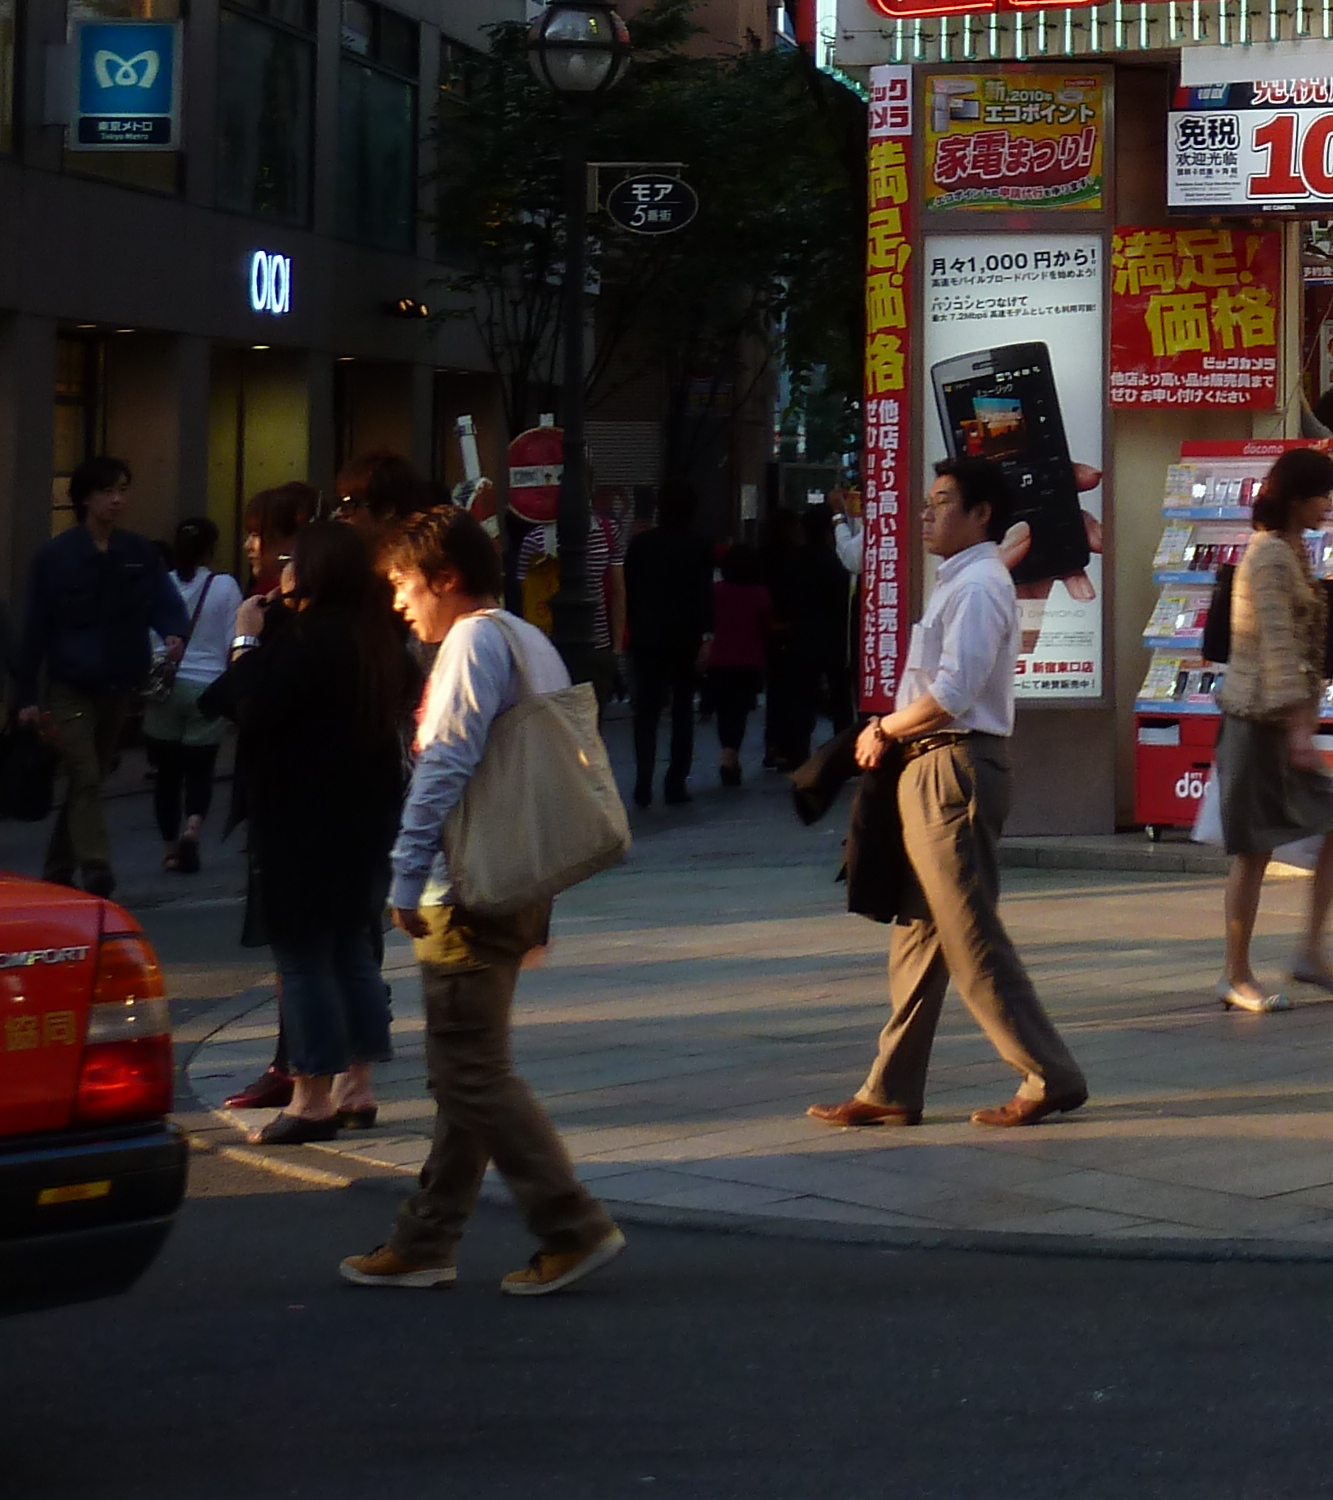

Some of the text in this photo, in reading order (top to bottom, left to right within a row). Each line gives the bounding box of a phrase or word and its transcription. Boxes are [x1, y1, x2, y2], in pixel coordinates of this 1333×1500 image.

[984, 104, 1096, 124] エコポイント
[98, 121, 153, 132] 東京メトロ
[1177, 116, 1239, 148] 免税
[934, 126, 1096, 184] 家電まつり!
[1175, 152, 1238, 166] 欢迎光临
[631, 184, 674, 202] モア
[630, 204, 673, 227] 5番街
[930, 248, 1097, 276] 月々1,000 円から!
[1112, 230, 1262, 296] 満足!
[931, 268, 1097, 288] 高速モバイルブロードバンドを始めよう!
[931, 295, 1029, 312] パソコンとつなげて
[1144, 286, 1277, 357] 価格
[1202, 357, 1276, 370] ビックカメラ
[1110, 371, 1275, 388] 他店より高い品は販売員まで
[1110, 388, 1251, 403] ぜひ お申し付けください
[1243, 443, 1285, 455] docomo
[877, 399, 899, 698] 他店より高い品は販売員まで
